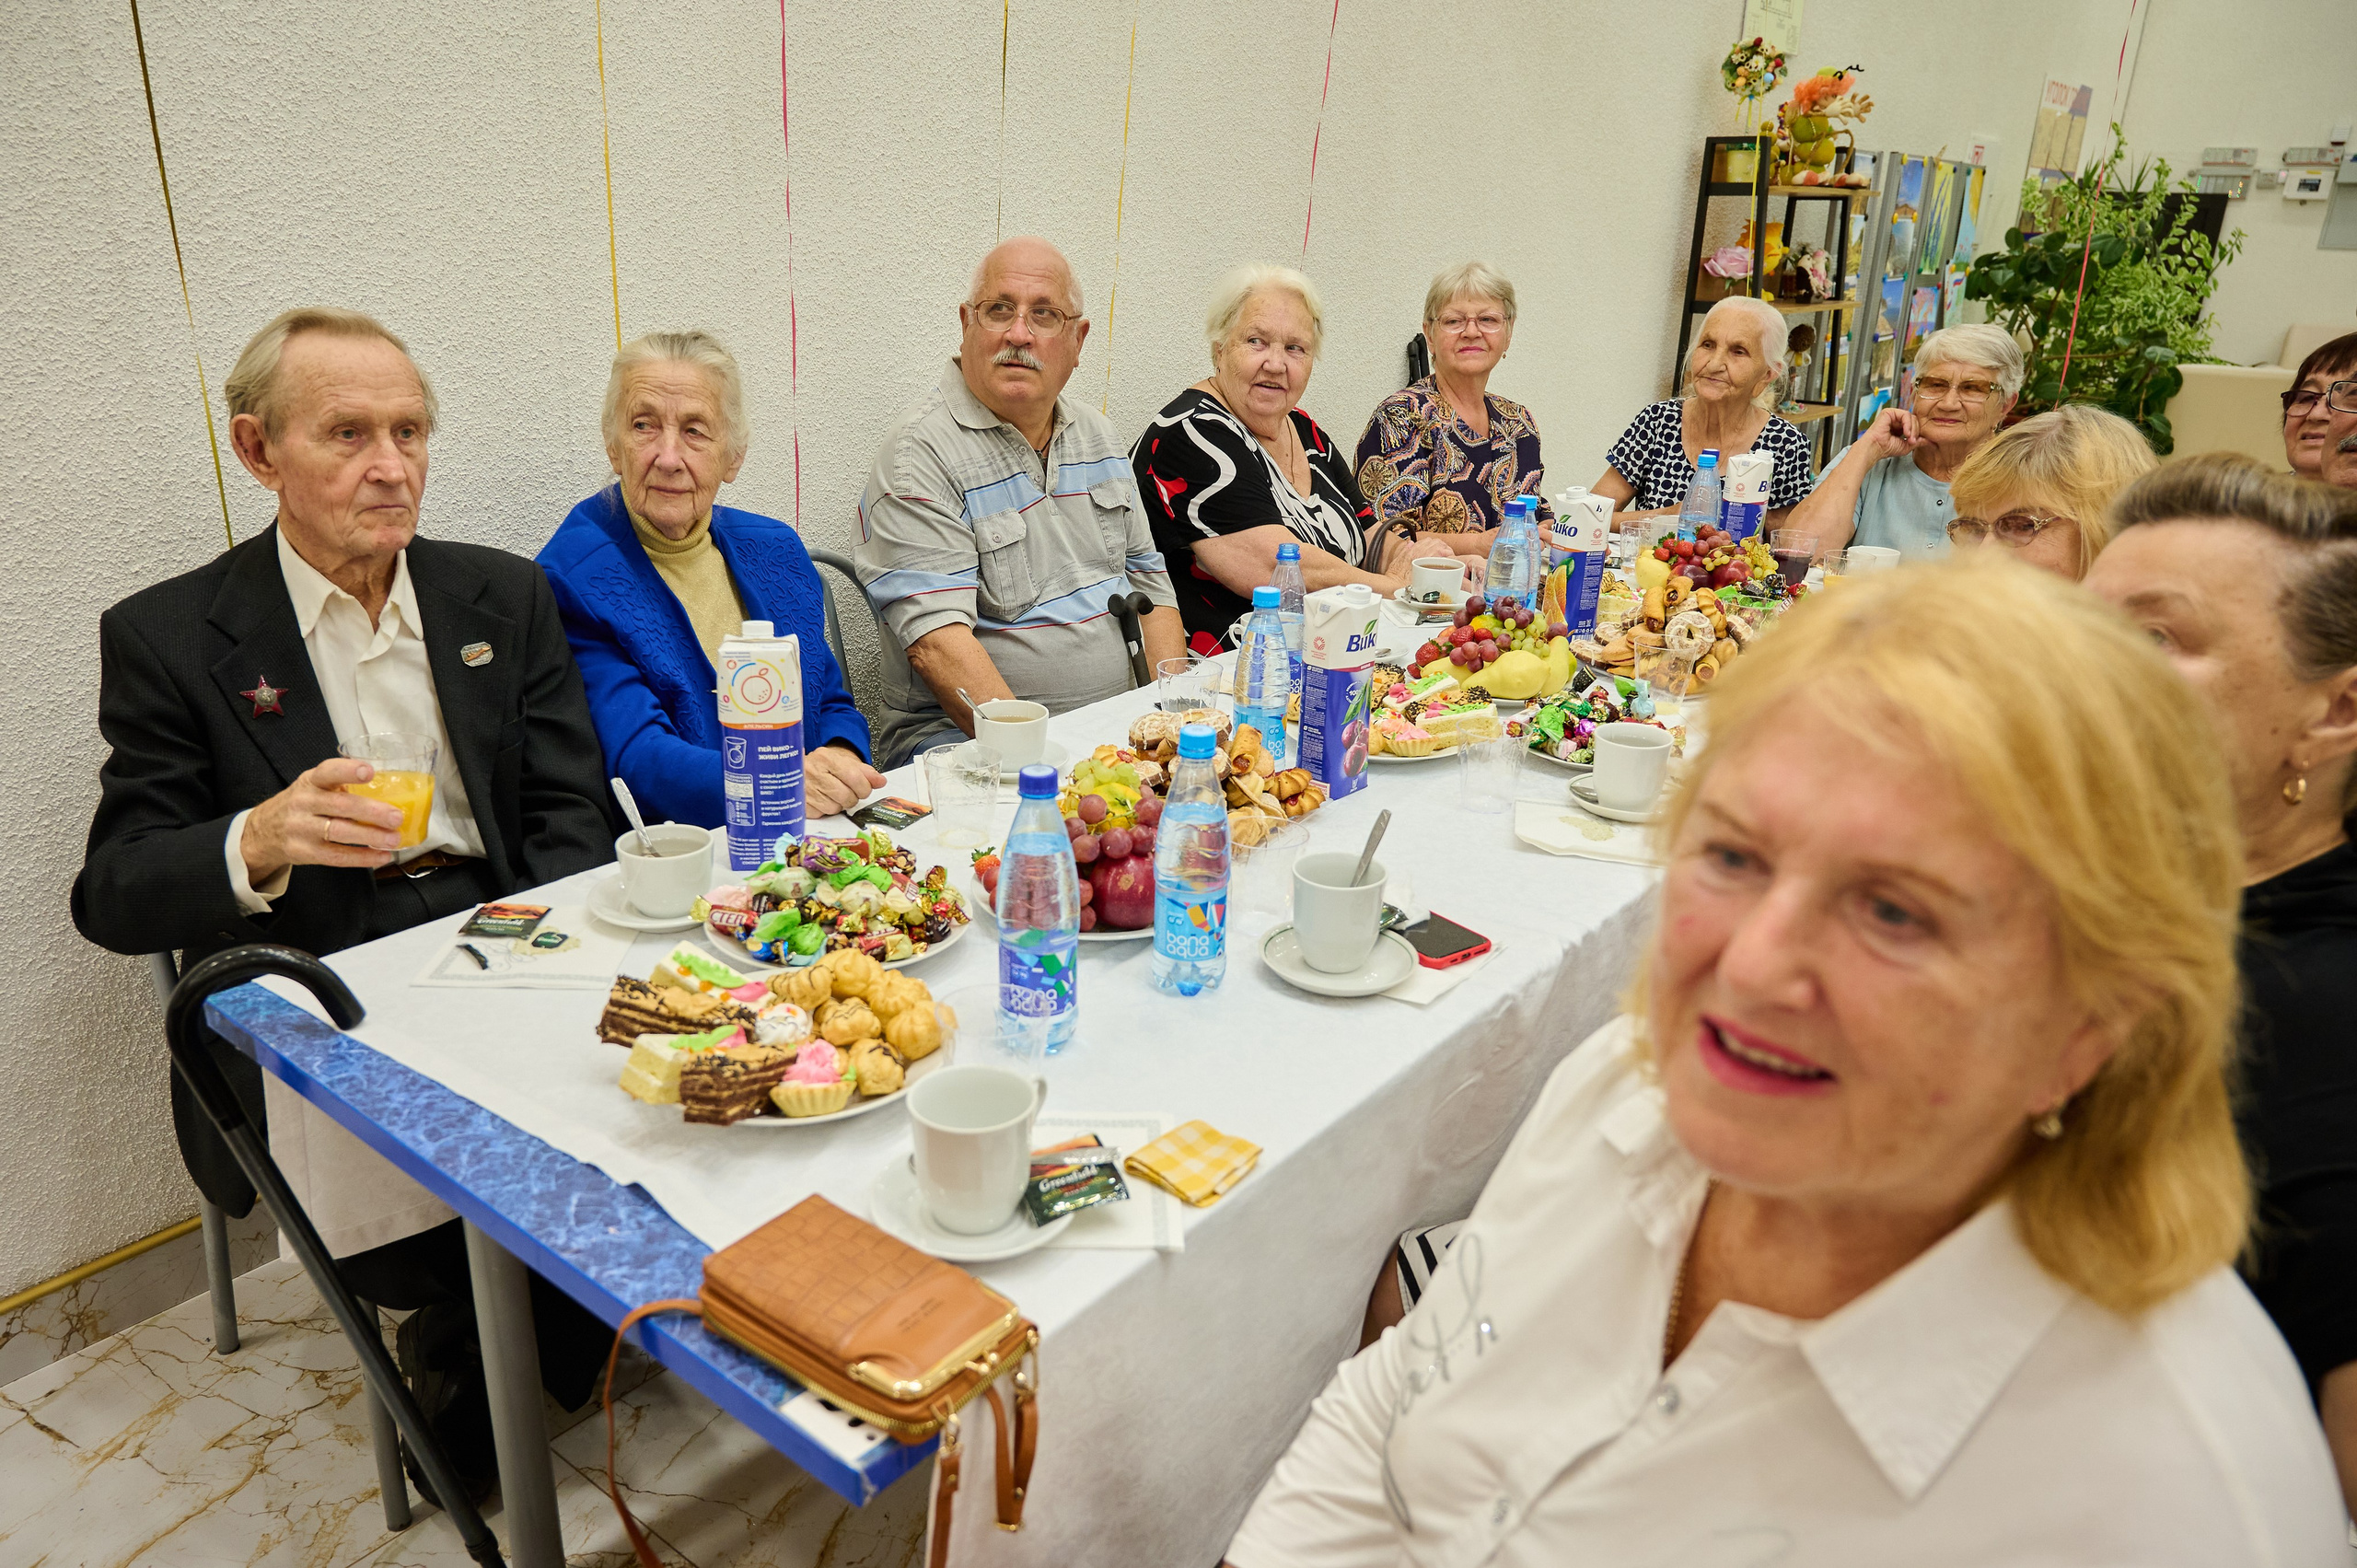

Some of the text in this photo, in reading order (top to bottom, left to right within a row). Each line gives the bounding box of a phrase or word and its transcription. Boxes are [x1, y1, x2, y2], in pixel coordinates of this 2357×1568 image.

[1346, 633, 1376, 652] Вик
[779, 749, 799, 760] ЛЕГКО!
[711, 911, 744, 924] СТЕП
[1167, 930, 1210, 947] bona
[1166, 944, 1210, 958] aqua
[1039, 1164, 1100, 1193] Greenfield
